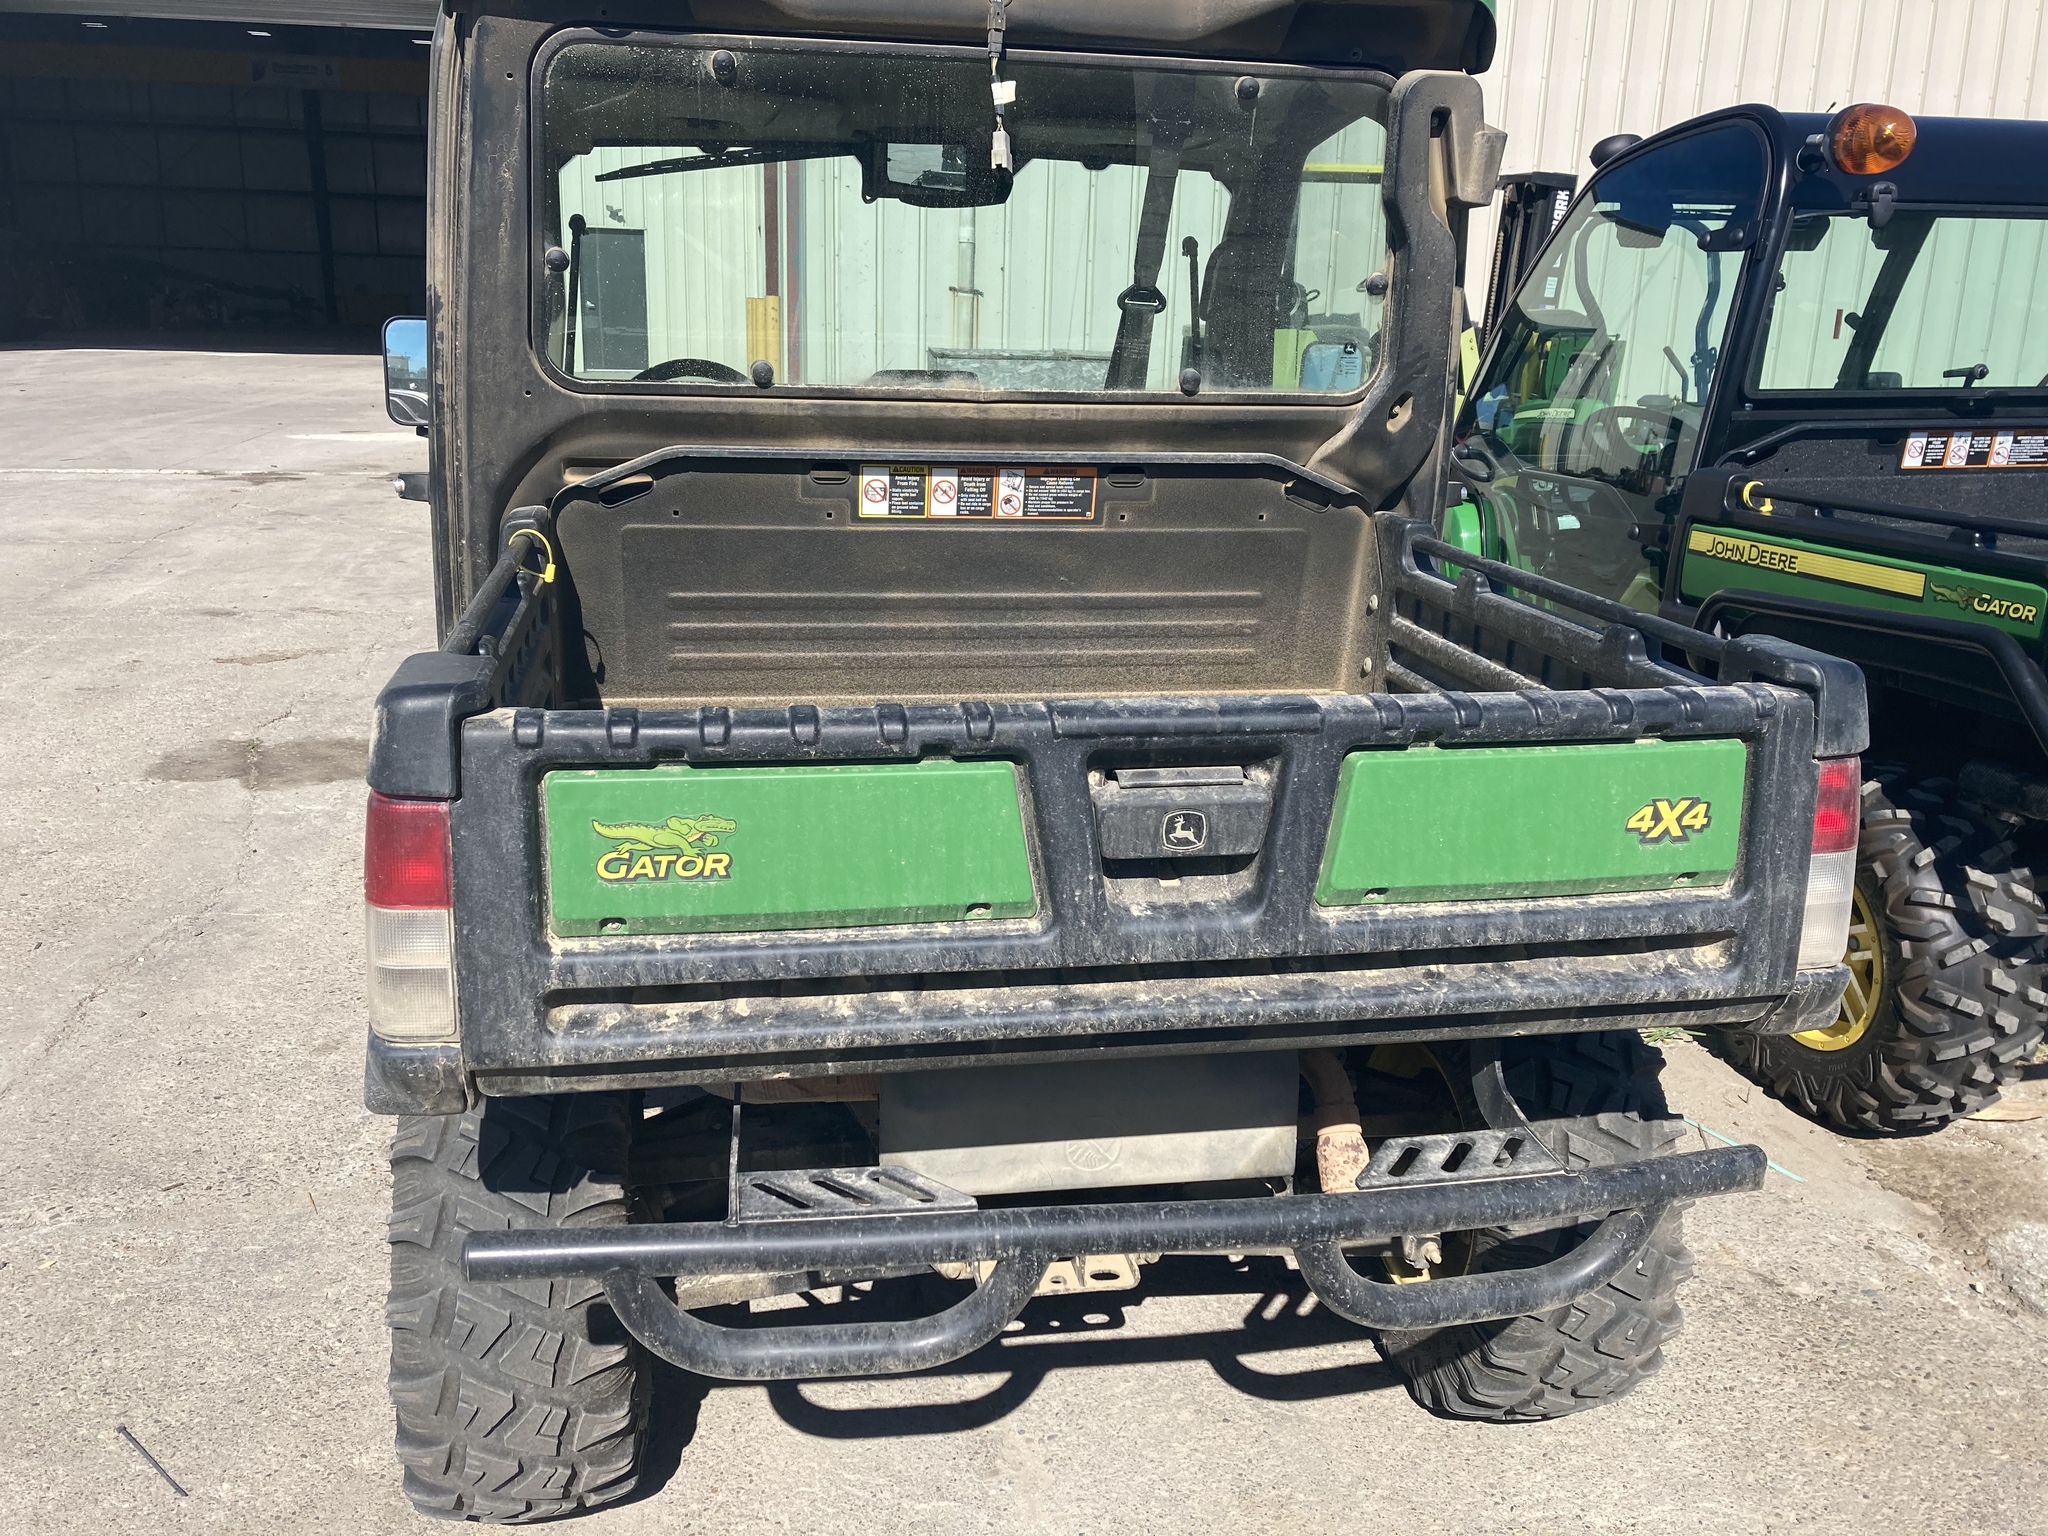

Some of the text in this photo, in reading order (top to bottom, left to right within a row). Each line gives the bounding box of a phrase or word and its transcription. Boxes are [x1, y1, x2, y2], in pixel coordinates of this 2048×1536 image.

[1706, 537, 1798, 571] JOHN DEERE
[1973, 594, 2037, 623] GATOR
[1626, 798, 1710, 842] 4X4
[596, 850, 732, 881] GATOR
